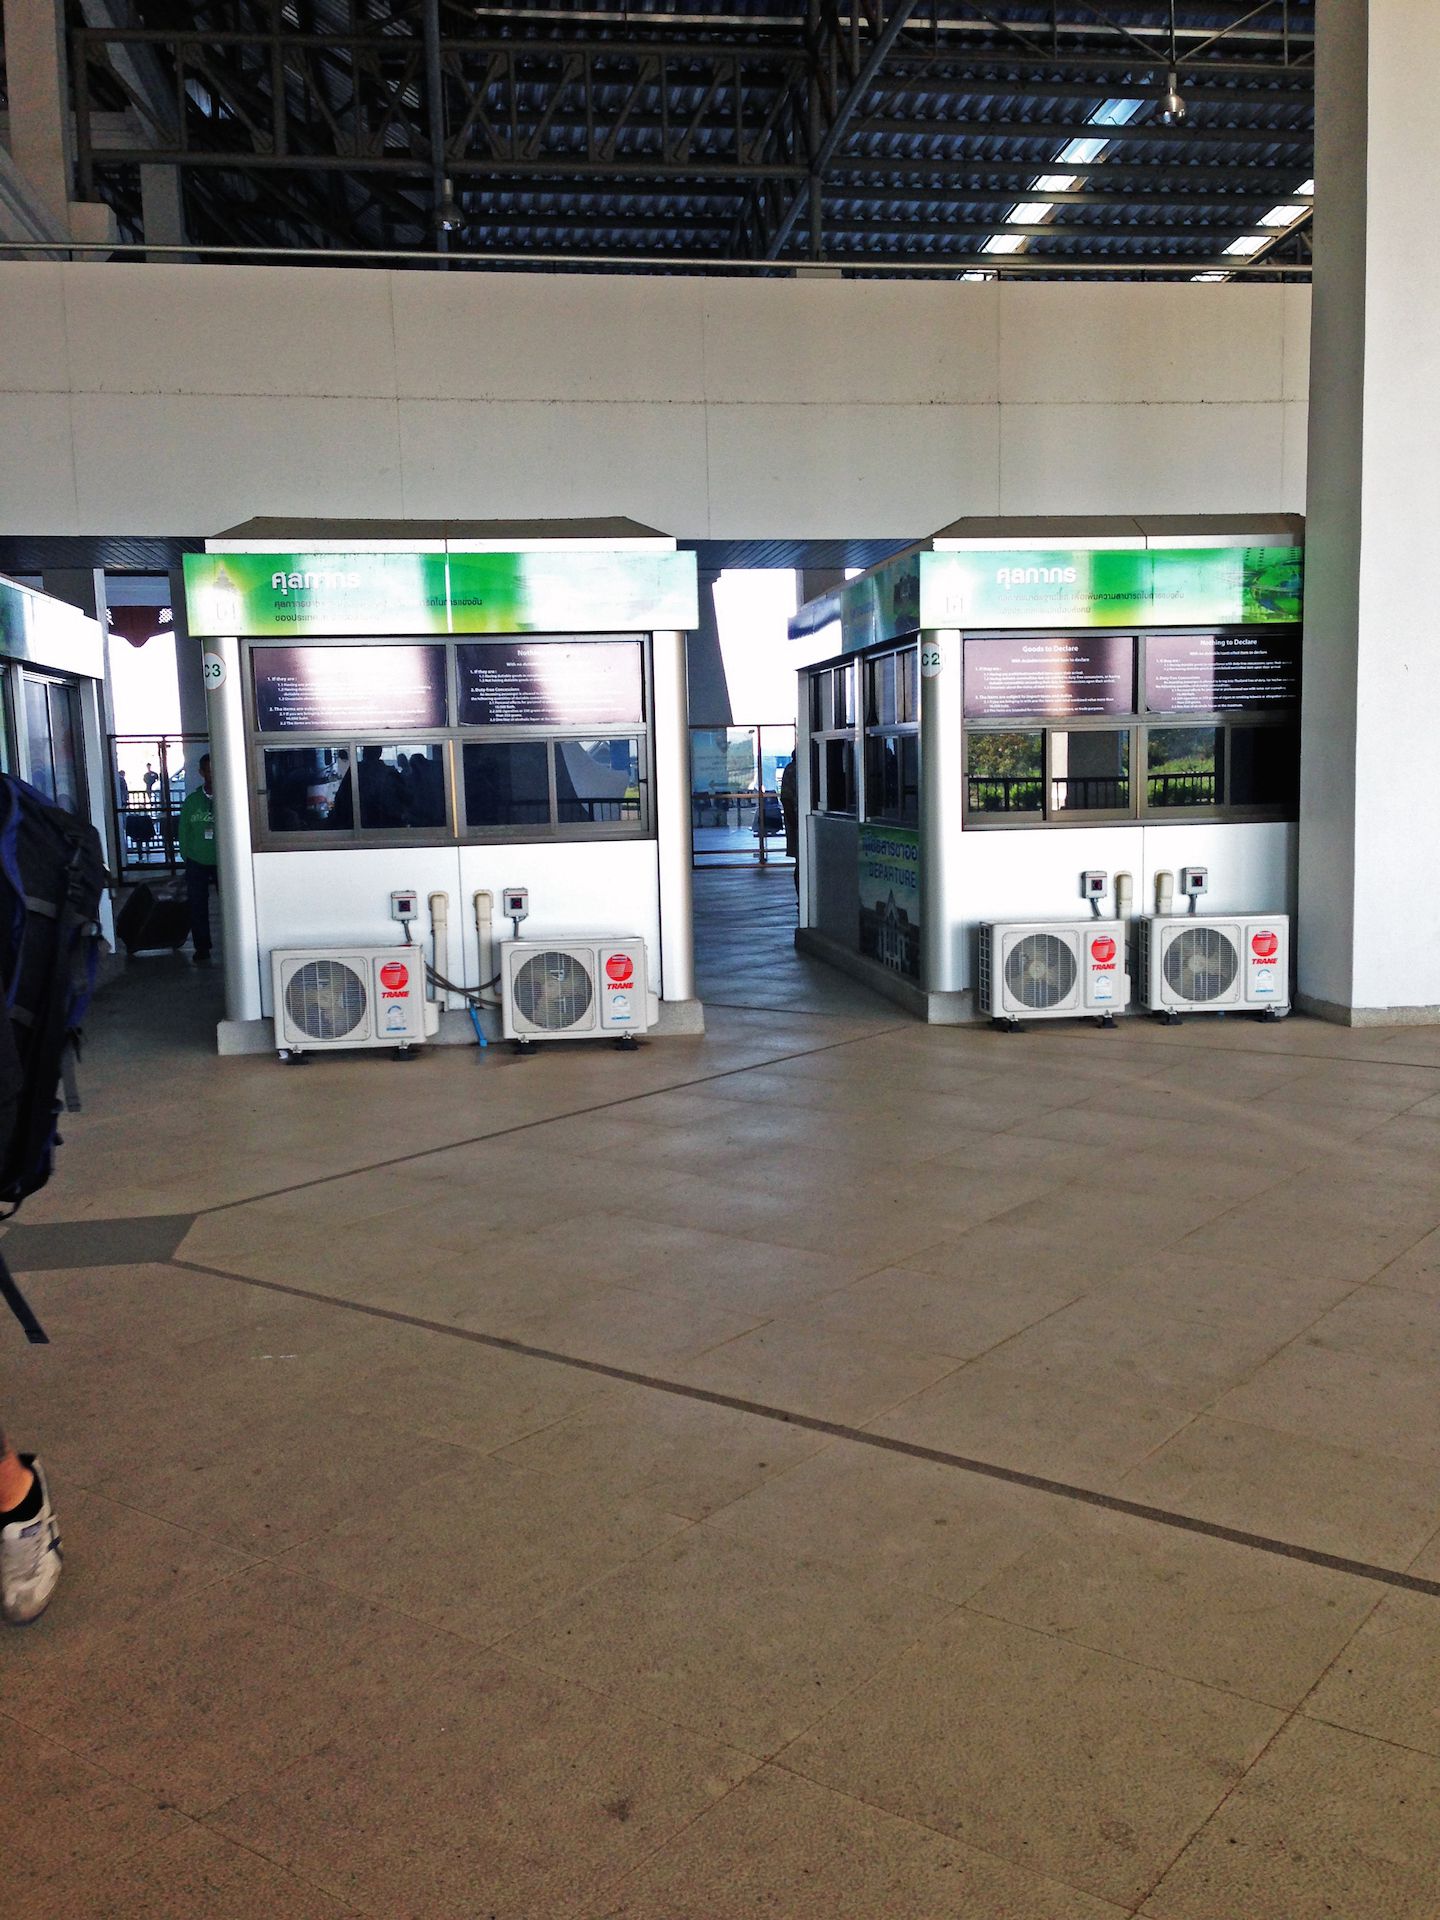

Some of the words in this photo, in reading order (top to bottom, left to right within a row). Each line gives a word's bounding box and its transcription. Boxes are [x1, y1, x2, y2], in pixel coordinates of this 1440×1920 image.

[996, 566, 1077, 590] ศุลกากร
[271, 570, 362, 596] ศุลกากร
[1200, 639, 1225, 647] Nothing
[1022, 645, 1044, 653] Goods
[1053, 644, 1079, 652] Declare
[921, 652, 941, 666] C2
[869, 862, 916, 888] DEPARTURE
[1251, 957, 1278, 965] TRANE
[1091, 963, 1117, 971] TRANE
[606, 982, 634, 990] TRANE
[381, 990, 410, 999] TRANE
